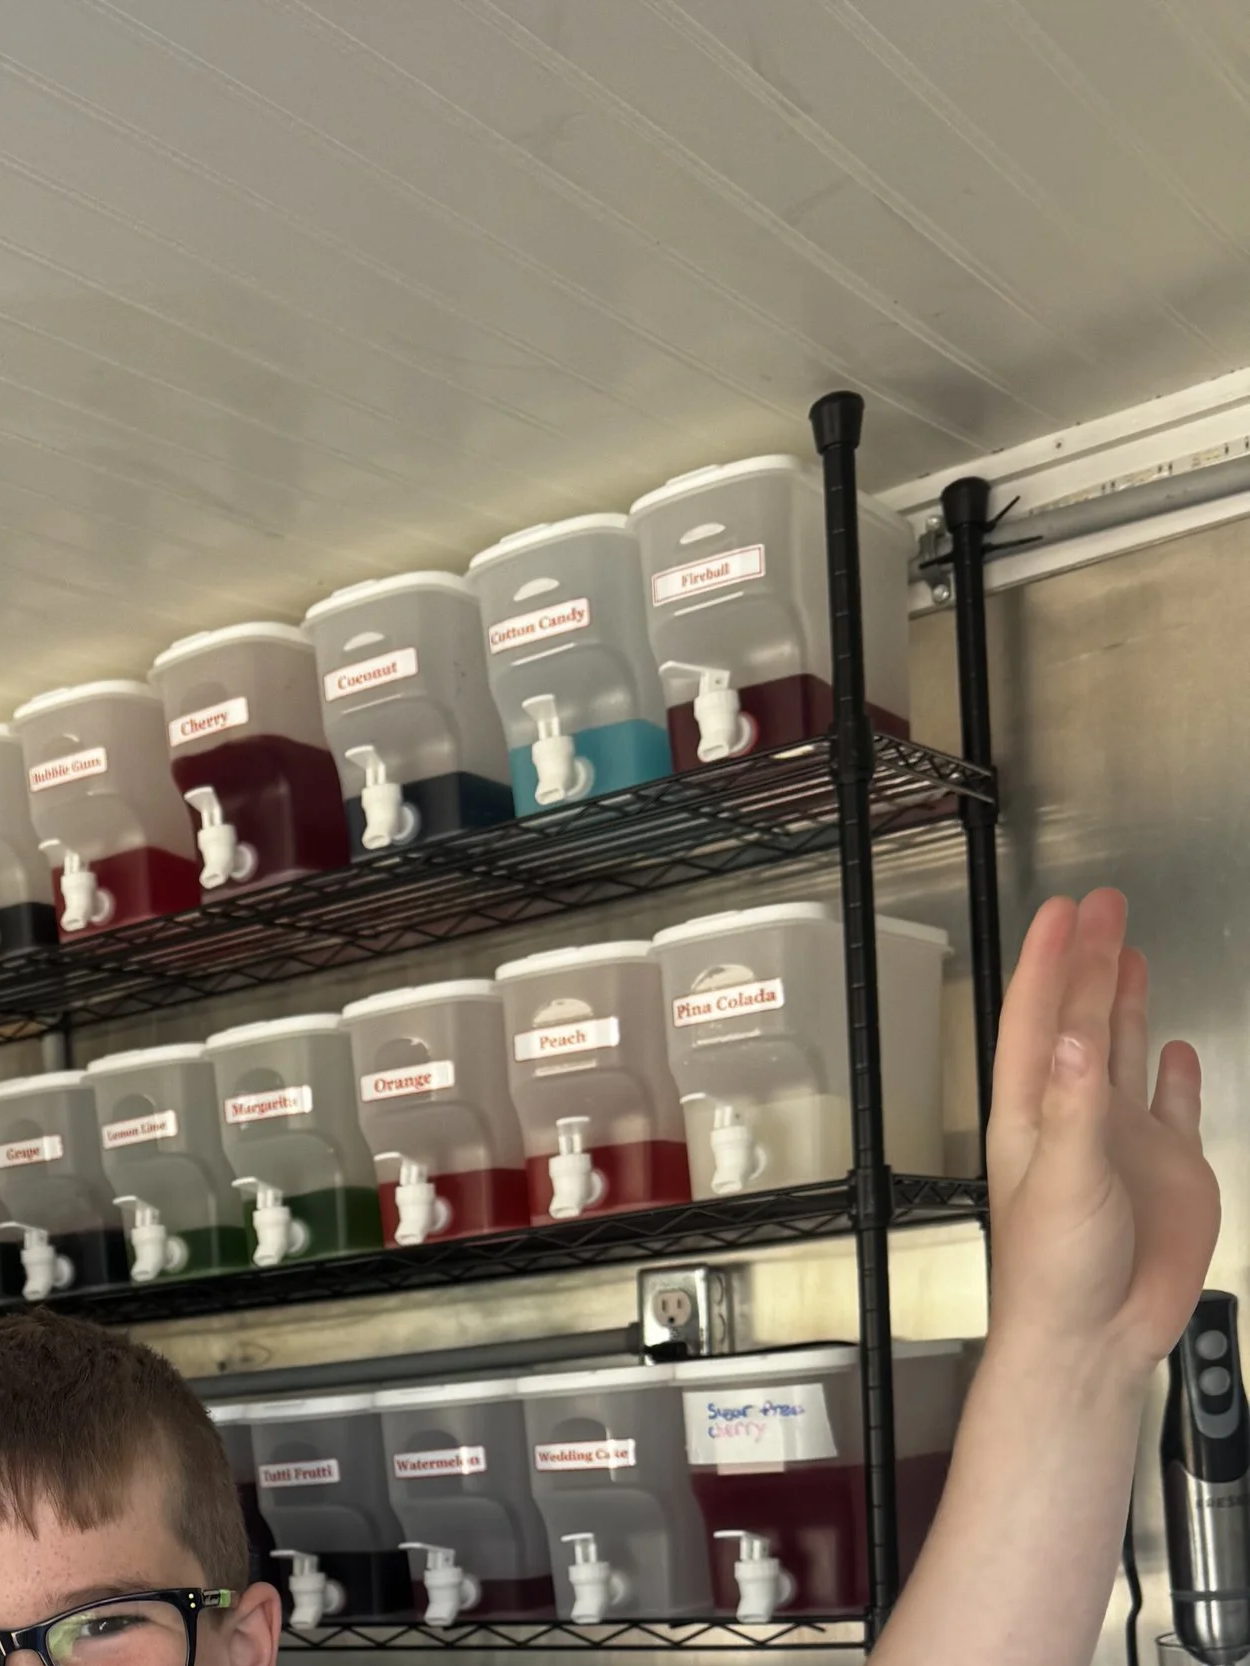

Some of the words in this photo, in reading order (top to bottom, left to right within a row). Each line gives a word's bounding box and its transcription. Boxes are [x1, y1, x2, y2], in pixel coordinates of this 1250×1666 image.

[681, 562, 730, 588] Fireball
[538, 607, 585, 630] Candy
[337, 661, 398, 690] Coconut
[180, 710, 229, 737] Cherry
[676, 1003, 712, 1019] Pina
[716, 988, 777, 1011] Colada
[539, 1030, 587, 1050] Peach
[374, 1071, 432, 1093] Orange
[707, 1403, 753, 1421] Sugar
[538, 1450, 593, 1463] Wedding
[294, 1464, 333, 1481] Frutti
